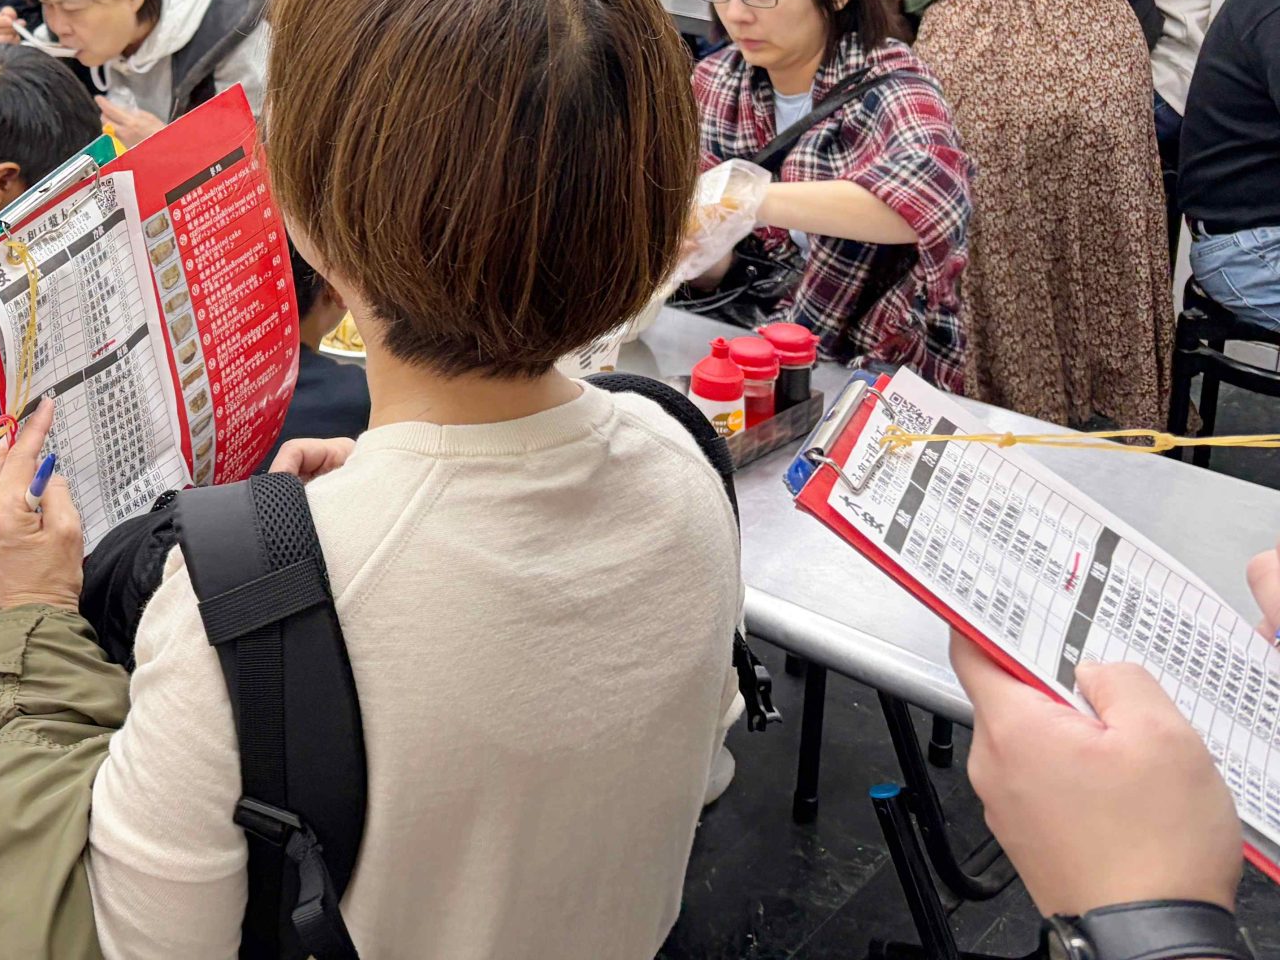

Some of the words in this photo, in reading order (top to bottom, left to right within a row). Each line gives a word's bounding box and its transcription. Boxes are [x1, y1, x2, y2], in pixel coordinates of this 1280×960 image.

[256, 182, 265, 194] 60
[228, 227, 241, 241] cake
[262, 207, 271, 218] 40
[252, 240, 264, 253] cake
[267, 230, 276, 242] 50
[245, 273, 257, 285] cake
[271, 253, 281, 266] 60
[276, 277, 285, 290] 30
[280, 301, 289, 313] 50
[54, 343, 63, 355] 50
[56, 420, 65, 432] 20
[151, 470, 160, 483] 40
[155, 481, 164, 495] 30
